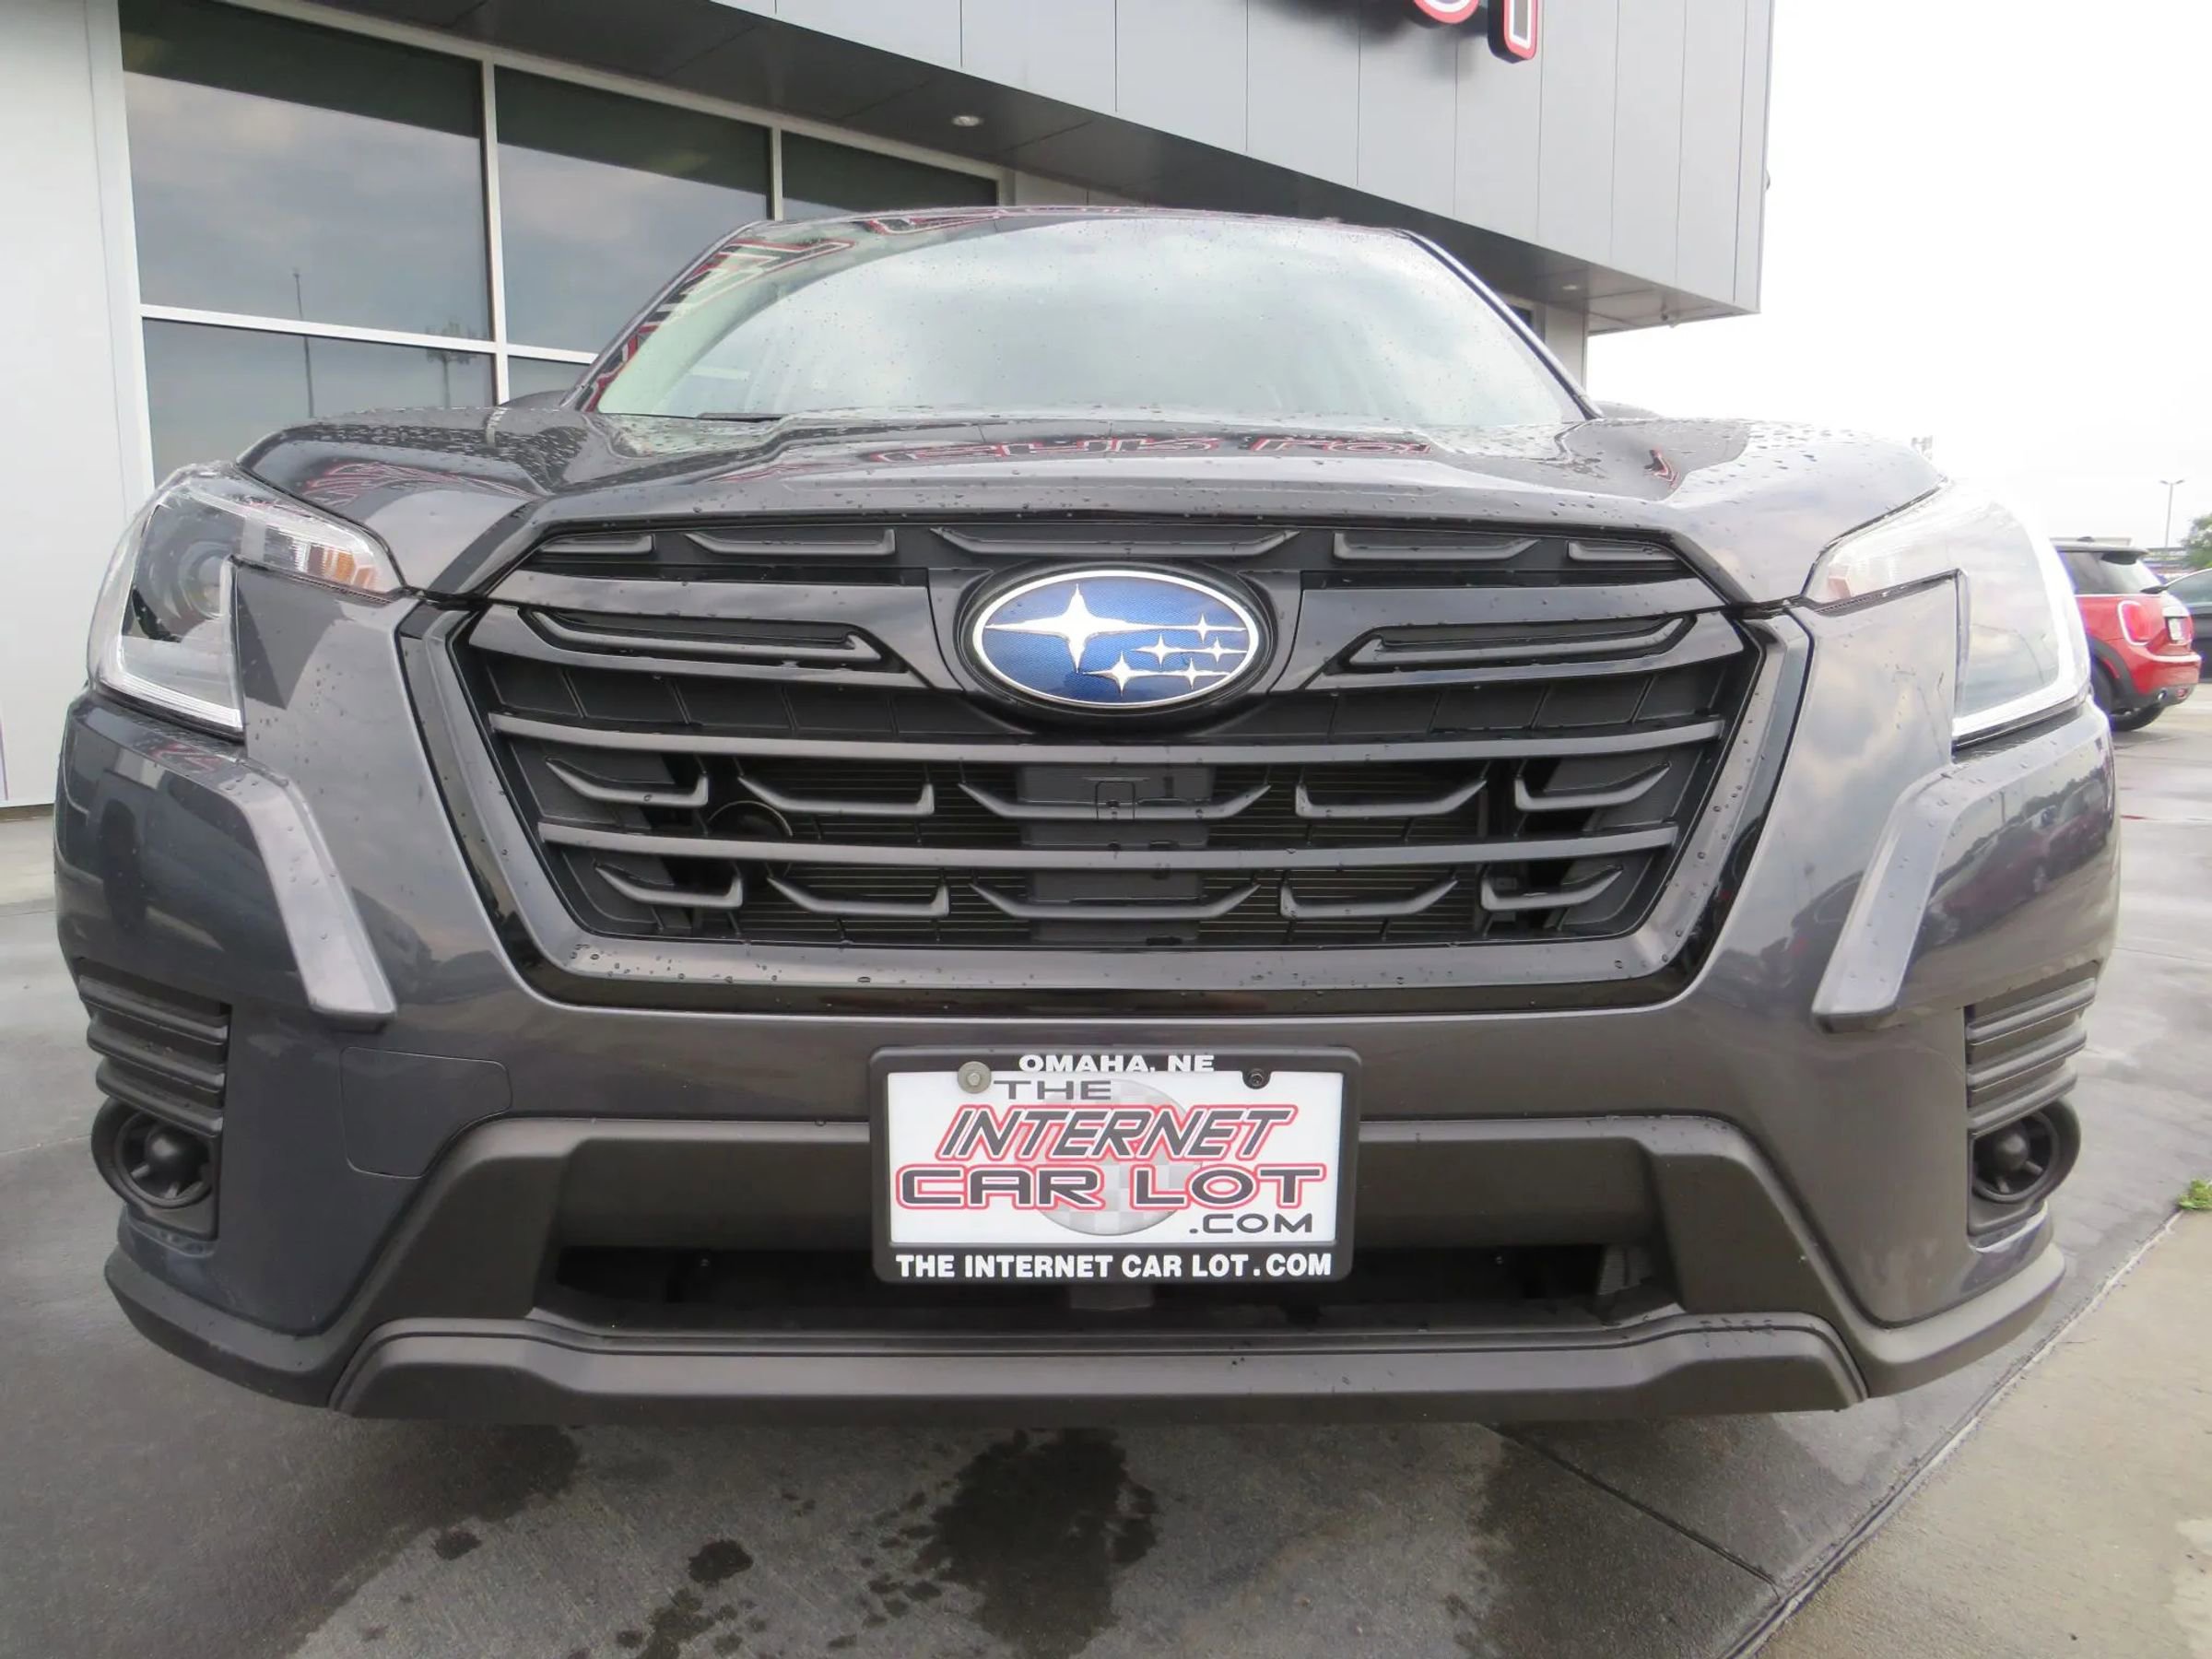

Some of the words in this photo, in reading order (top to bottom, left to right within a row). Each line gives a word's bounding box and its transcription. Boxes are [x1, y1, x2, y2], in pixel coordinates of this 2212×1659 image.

[1167, 1054, 1215, 1073] NE
[993, 1080, 1112, 1100] THE
[936, 1105, 1296, 1160] INTERNET
[898, 1165, 1103, 1208] CAR
[1131, 1165, 1324, 1208] LOT
[1189, 1212, 1312, 1234] .COM
[895, 1254, 955, 1277] THE
[964, 1254, 1113, 1277] INTERNET
[1121, 1254, 1182, 1277] CAR
